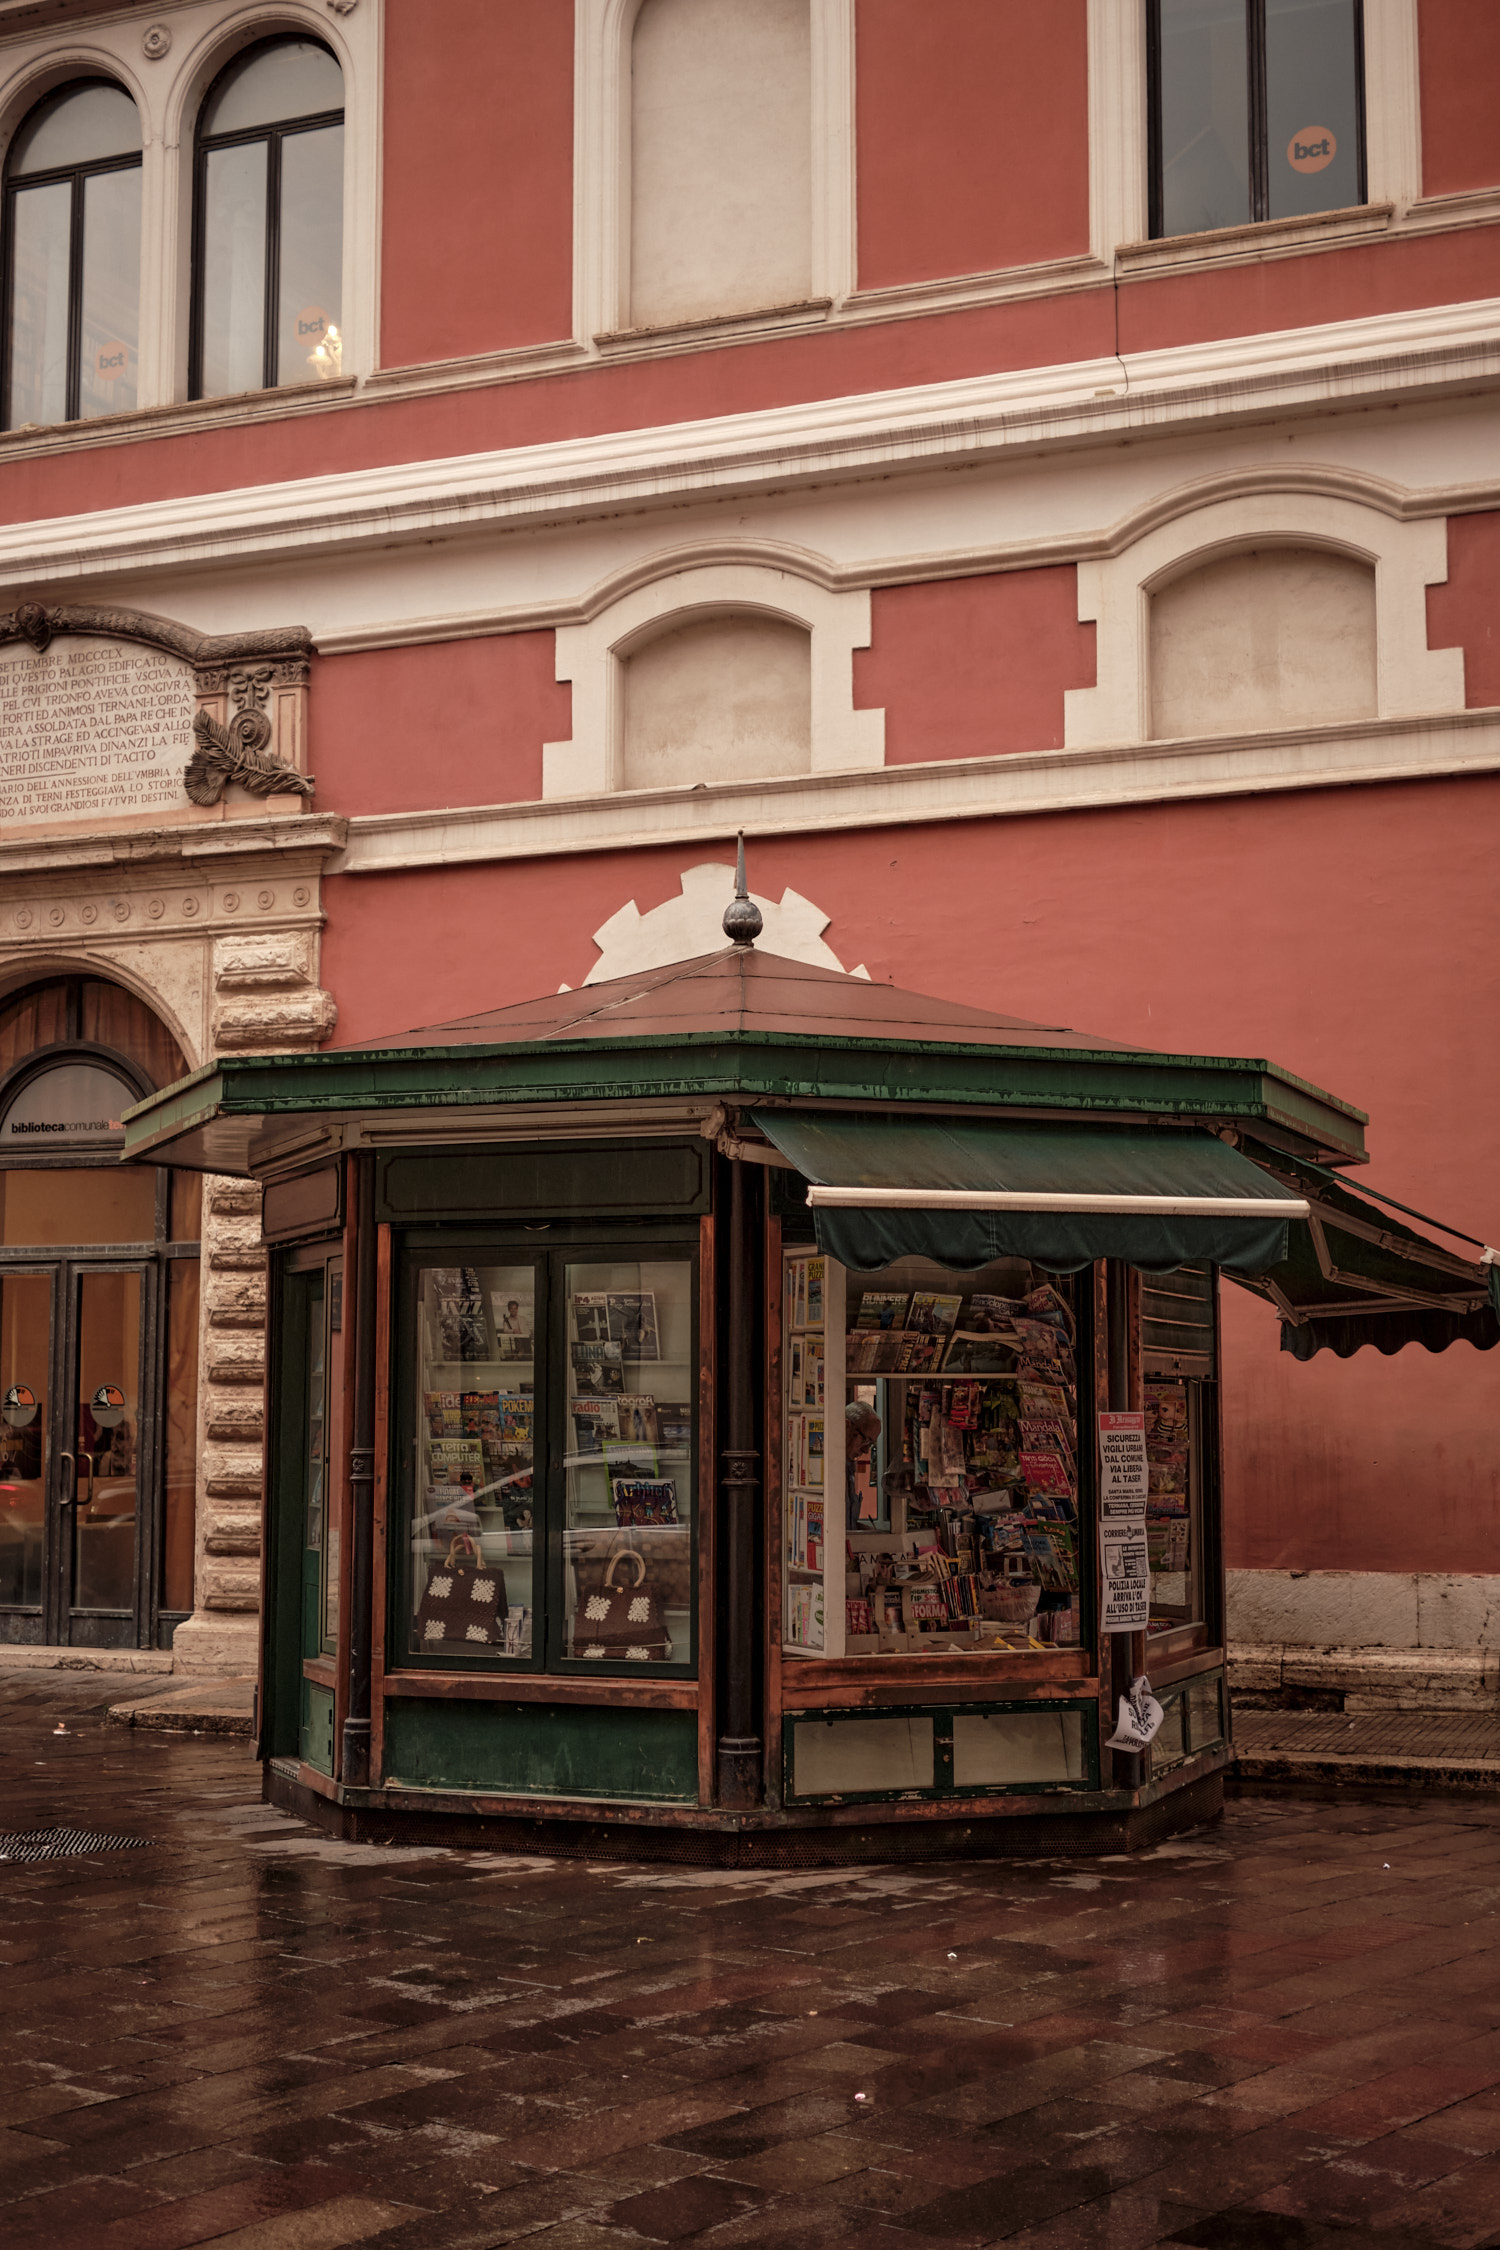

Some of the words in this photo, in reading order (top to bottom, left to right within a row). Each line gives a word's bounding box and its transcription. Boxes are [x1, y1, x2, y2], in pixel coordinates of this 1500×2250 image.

[1294, 138, 1330, 160] bct
[298, 316, 325, 336] bct
[99, 351, 125, 370] bct
[0, 656, 62, 673] SETTEMBRE
[68, 648, 122, 665] MDCCCLX
[12, 669, 56, 686] QVESTO
[60, 663, 106, 678] PALAGIO
[109, 655, 167, 672] EDIFICATO
[21, 681, 67, 696] PRIGIONI
[71, 673, 131, 690] PONTIFICIE
[135, 669, 172, 681] VSCIVA
[176, 666, 191, 677] AL
[3, 700, 20, 711] PEL
[22, 697, 41, 708] CVI
[44, 691, 91, 706] TRIONFO
[93, 687, 128, 700] AVEVA
[3, 711, 33, 724] FORTI
[36, 709, 49, 721] ED
[51, 703, 95, 718] ANIMOSI
[26, 719, 87, 735] ASSOLDATA
[90, 715, 111, 728] DAL
[114, 712, 138, 724] PAPA
[140, 710, 153, 721] RE
[155, 707, 177, 719] CHE
[180, 706, 191, 717] IN
[15, 738, 29, 749] LA
[32, 733, 73, 747] STRAGE
[76, 731, 90, 742] ED
[93, 722, 160, 739] ACCINGEVASI
[162, 719, 191, 732] ALLO
[43, 744, 97, 759] IMPAVRIVA
[100, 737, 148, 752] DINANZI
[152, 736, 167, 746] LA
[28, 756, 98, 773] DISCENDENTI
[100, 754, 111, 766] DI
[114, 750, 156, 764] TACITO
[0, 784, 24, 795] ARIO
[23, 794, 32, 804] DI
[36, 791, 63, 802] TERNI
[66, 784, 125, 799] FESTEGGIAVA
[130, 783, 143, 792] LO
[148, 778, 184, 790] STORIC
[0, 808, 15, 818] DO
[18, 807, 27, 816] AI
[30, 804, 49, 815] SVOI
[50, 799, 99, 813] GRANDIOSI
[101, 795, 137, 807] FVTVRI
[141, 791, 180, 803] DESTINI
[862, 1294, 909, 1305] RUNNER'S
[573, 1401, 600, 1413] radio
[1020, 1421, 1060, 1432] Mandala
[1107, 1434, 1141, 1442] SICUREZZA
[1103, 1445, 1125, 1453] VIGILI
[432, 1452, 480, 1462] COMPUTER
[1104, 1455, 1119, 1463] DAL
[1120, 1454, 1143, 1463] COMUNE
[1110, 1465, 1121, 1473] VIA
[1123, 1464, 1142, 1473] LIBERA
[1112, 1475, 1122, 1483] AL
[1123, 1474, 1141, 1483] TASER
[808, 1503, 825, 1513] PUZZ
[1104, 1529, 1127, 1537] CORRIERE
[1109, 1580, 1129, 1590] POLIZIA
[1130, 1579, 1146, 1589] LOCALE
[1113, 1592, 1131, 1602] ARRIVA
[1106, 1602, 1128, 1613] ALL'USO
[1129, 1602, 1134, 1612] DI
[1135, 1602, 1146, 1611] TASER
